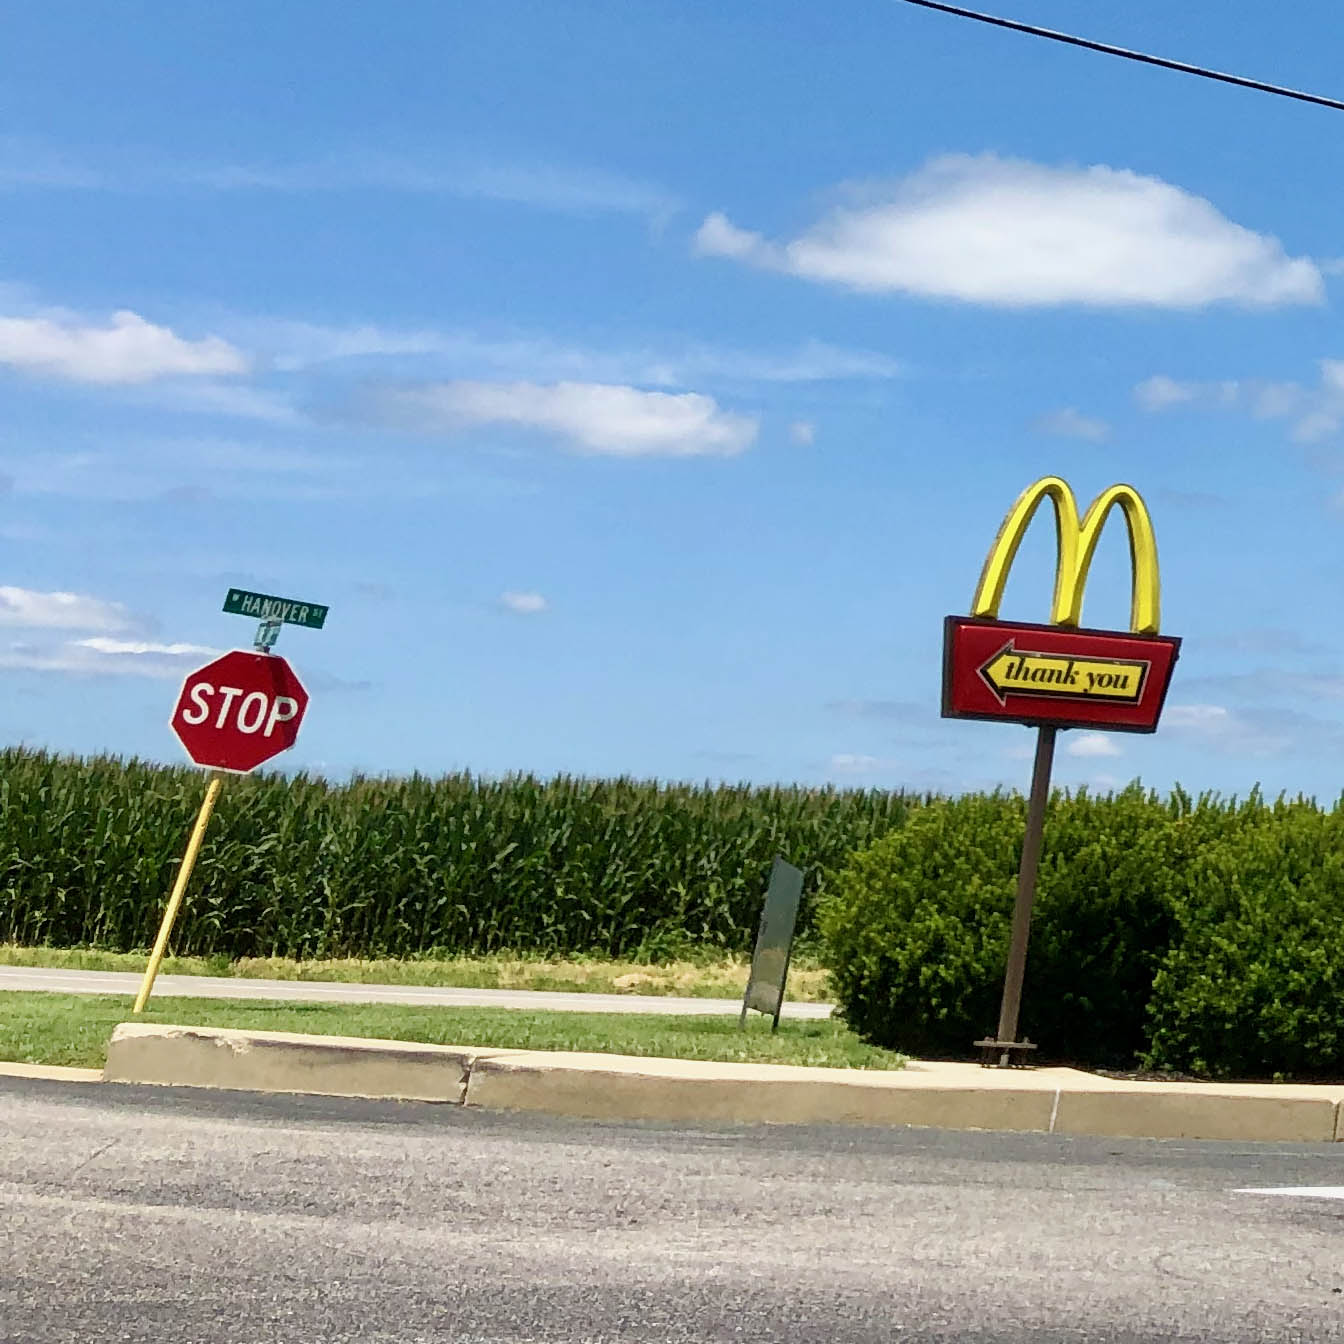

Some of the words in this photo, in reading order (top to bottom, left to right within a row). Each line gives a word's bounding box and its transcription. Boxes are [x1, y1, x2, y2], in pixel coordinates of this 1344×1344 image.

[241, 594, 310, 623] HANOVER
[1004, 657, 1080, 685] thank
[1083, 670, 1130, 693] you
[182, 682, 299, 738] STOP
